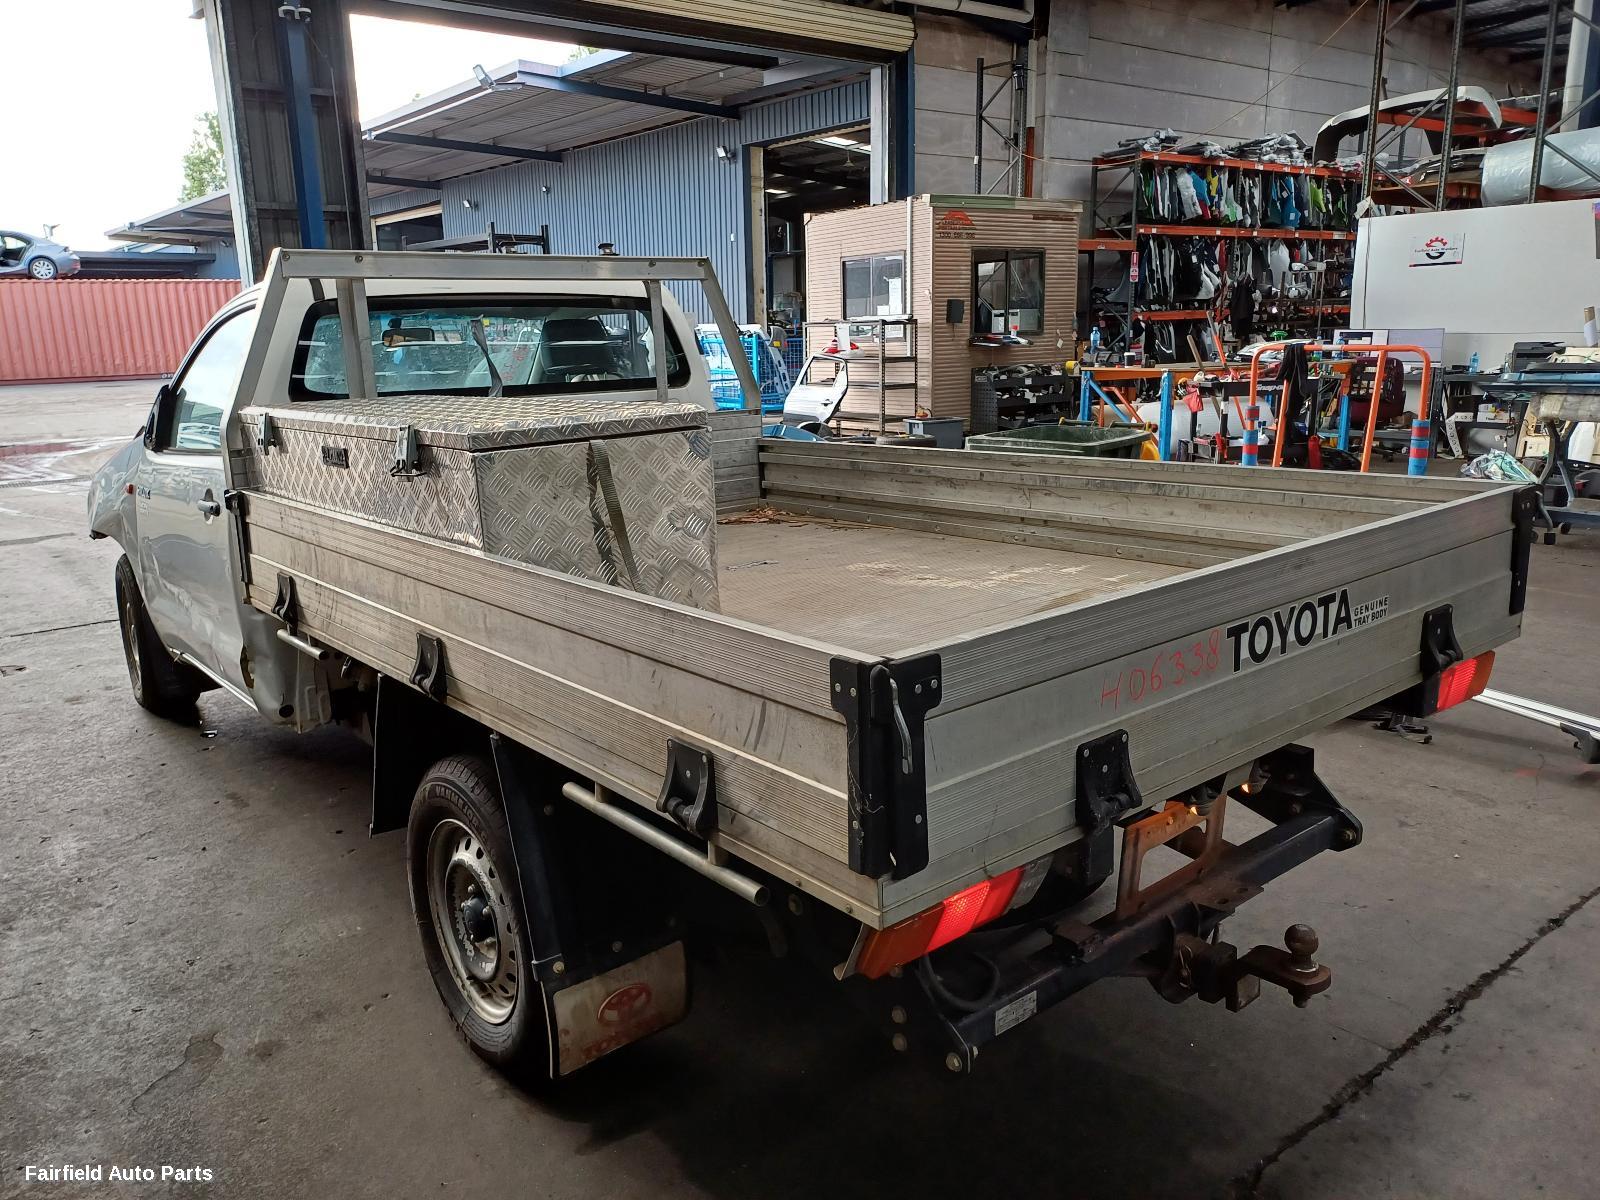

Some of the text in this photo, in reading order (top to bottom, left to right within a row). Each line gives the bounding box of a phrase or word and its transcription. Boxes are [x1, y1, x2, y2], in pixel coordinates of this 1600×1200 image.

[1227, 588, 1352, 673] TOYOTA
[1354, 596, 1388, 617] GENUINE
[1354, 608, 1388, 628] TRAY BODY
[1100, 630, 1223, 712] H06338
